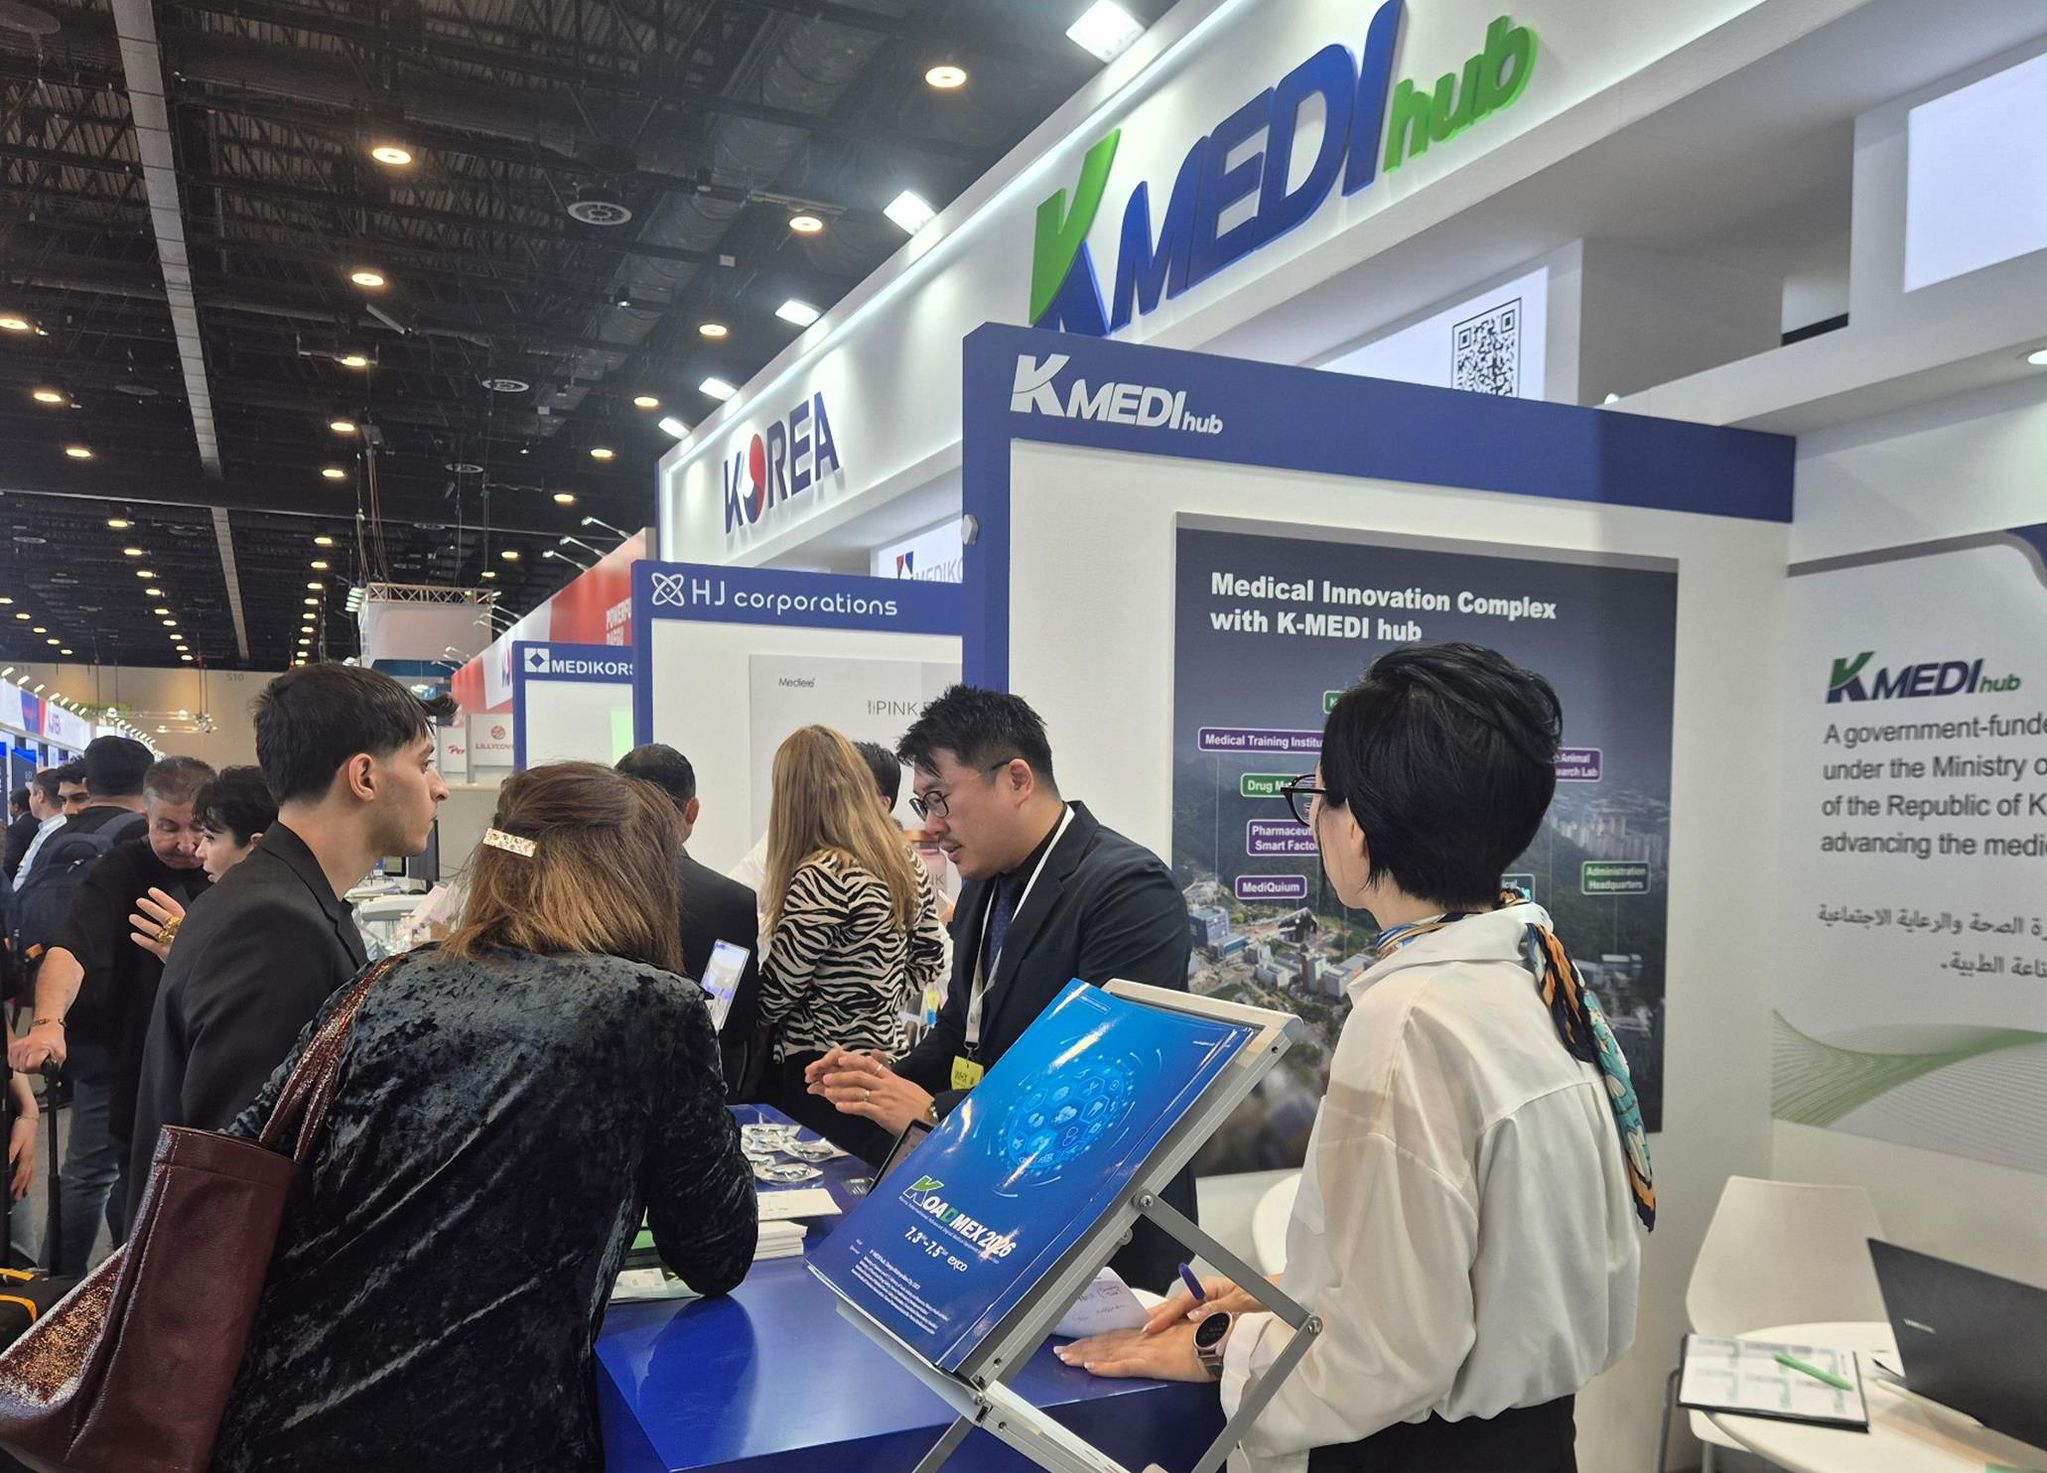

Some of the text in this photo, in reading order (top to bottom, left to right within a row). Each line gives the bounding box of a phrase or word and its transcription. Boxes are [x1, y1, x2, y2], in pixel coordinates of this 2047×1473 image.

[724, 392, 840, 535] KOREA
[692, 578, 898, 616] HJ corporations
[1211, 572, 1556, 621] Medical Innovation Complex
[1210, 610, 1422, 642] with K-MEDI hub
[1205, 734, 1245, 746] Medical
[1248, 735, 1289, 750] Training
[1823, 724, 1841, 744] A
[1561, 754, 1591, 763] Animal
[1823, 761, 1885, 781] under
[1889, 758, 1926, 779] the
[1933, 755, 2027, 782] Ministry
[1248, 780, 1273, 793] Drug
[1821, 795, 1843, 816] of
[1847, 796, 1881, 816] the
[1887, 794, 1990, 821] Republic
[1997, 793, 2022, 816] of
[1255, 840, 1285, 851] Smart
[1821, 832, 2047, 859] advancing the medi
[1969, 912, 2024, 934] الصحة
